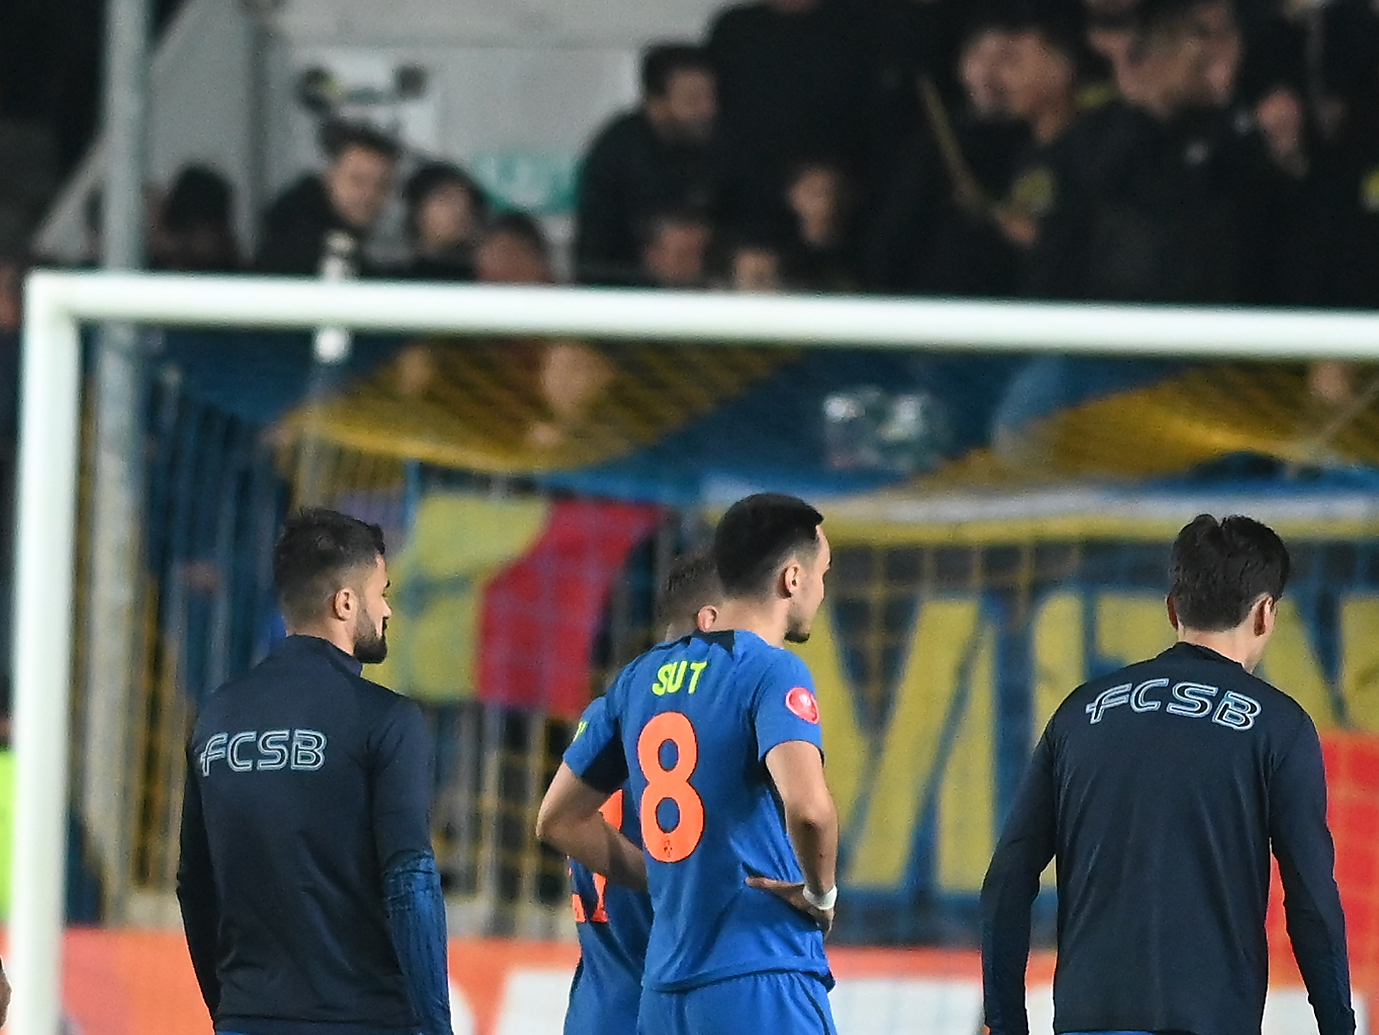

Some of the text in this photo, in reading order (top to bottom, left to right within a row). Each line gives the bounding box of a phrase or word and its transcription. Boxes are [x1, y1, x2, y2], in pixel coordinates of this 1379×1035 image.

[652, 660, 707, 695] SUT
[1085, 678, 1262, 731] FCSB
[200, 729, 328, 777] FCSB
[637, 711, 705, 862] 8
